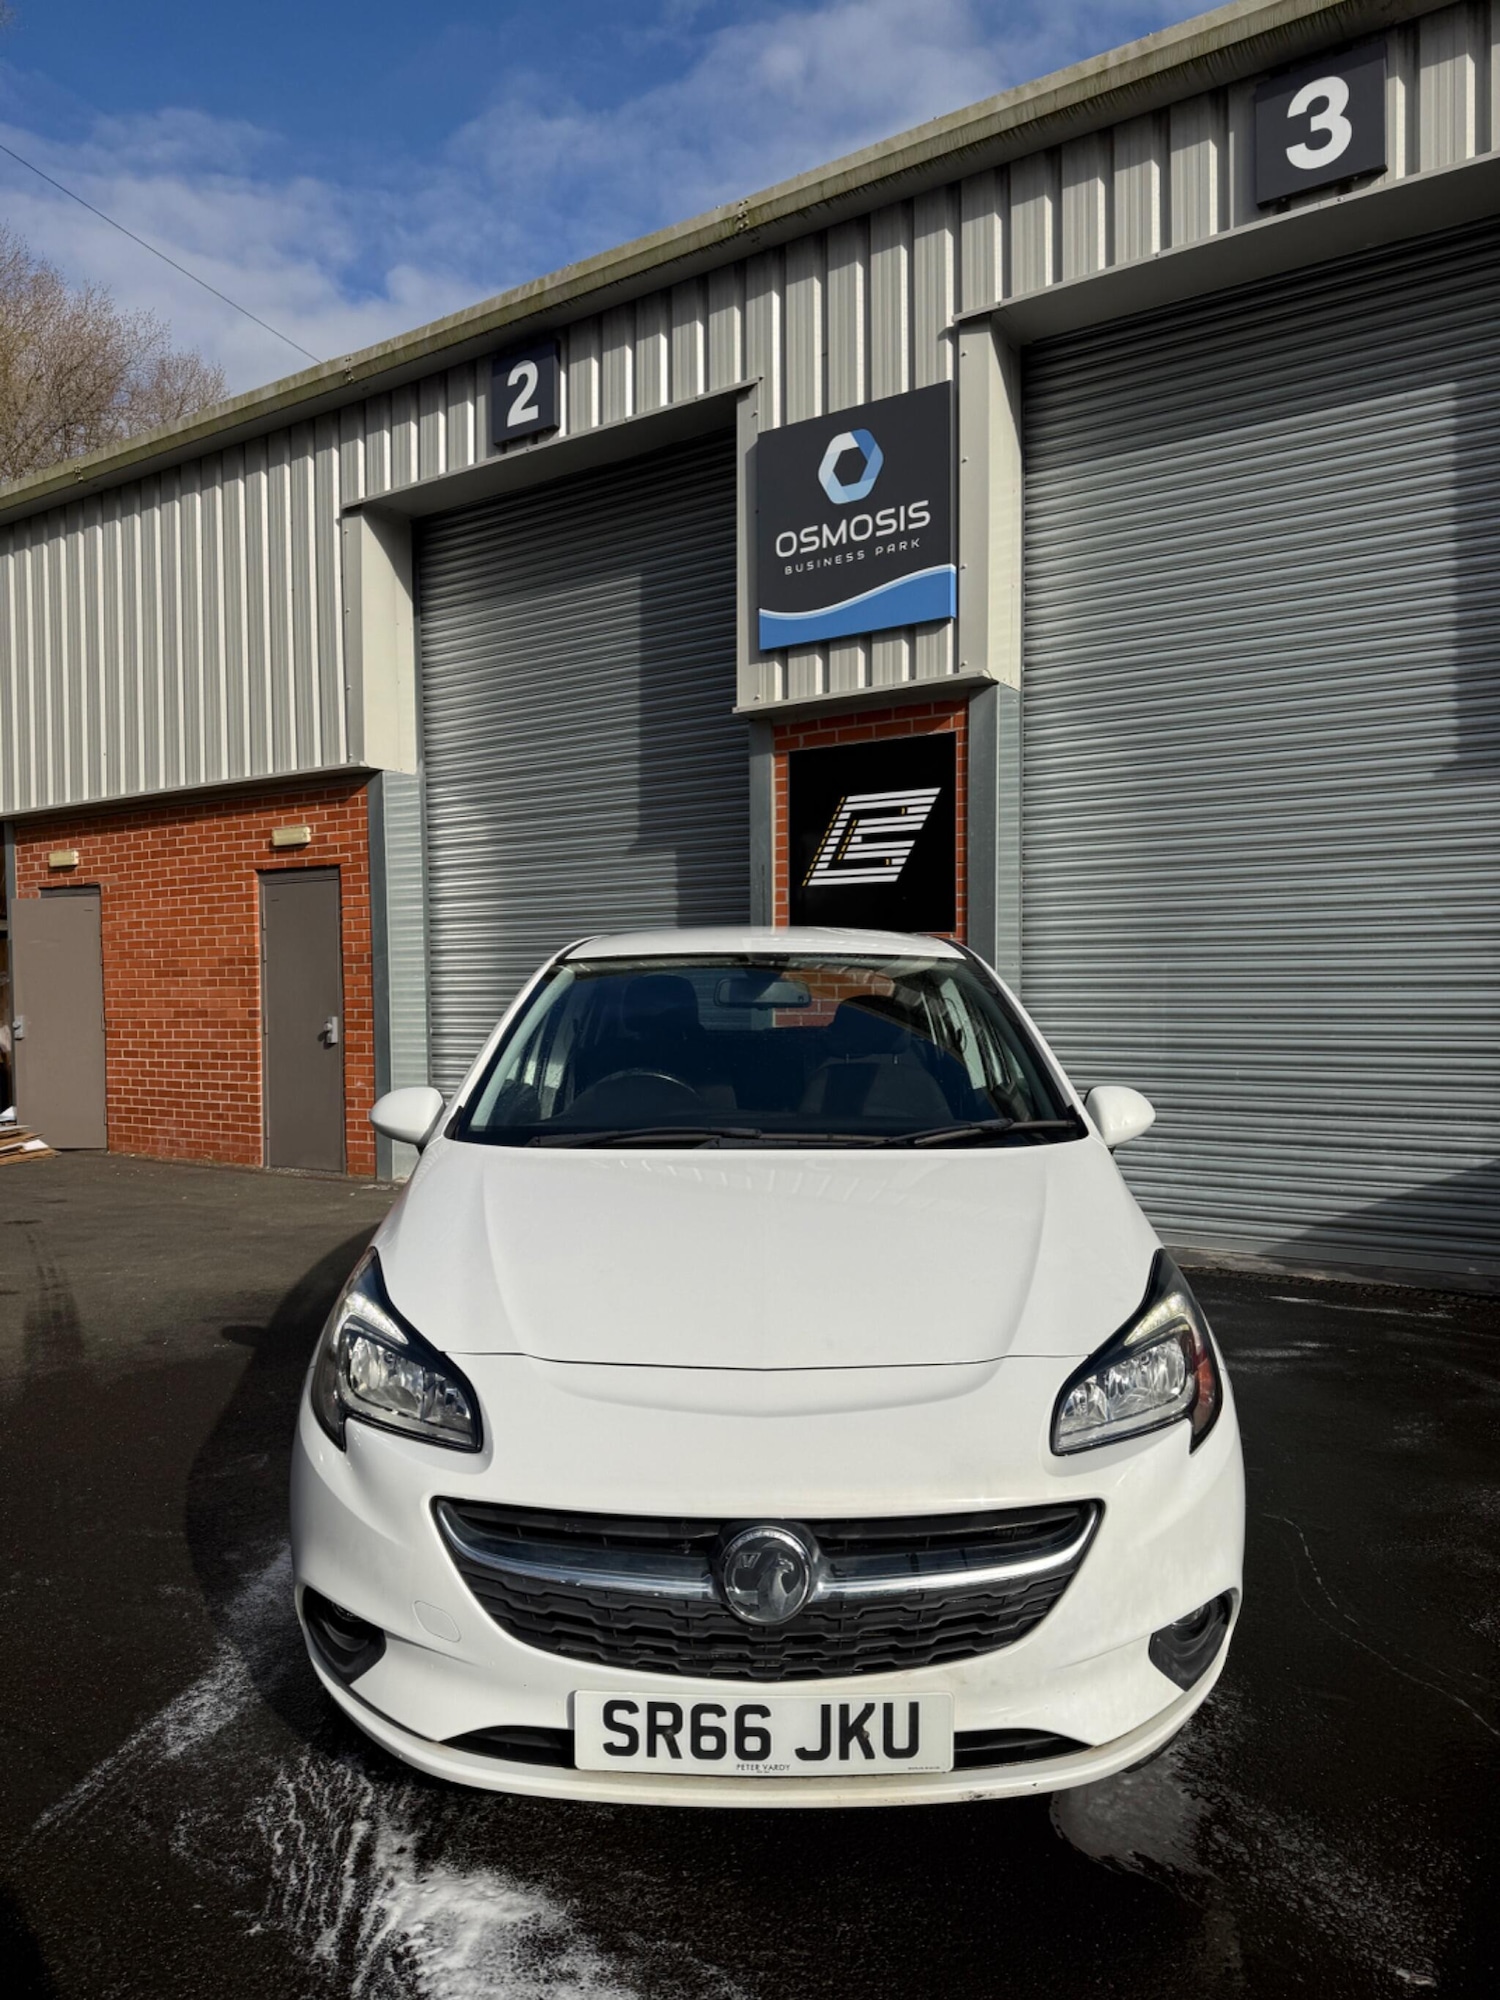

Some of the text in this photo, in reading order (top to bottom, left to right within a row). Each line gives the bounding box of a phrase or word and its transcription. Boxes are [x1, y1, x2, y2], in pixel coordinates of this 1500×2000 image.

[1286, 76, 1352, 170] 3
[507, 360, 538, 428] 2
[775, 500, 931, 557] OSMOSIS
[784, 537, 921, 575] BUSINESS PARK
[602, 1699, 920, 1761] SR66 JKU
[736, 1763, 790, 1771] PETER VARDY
